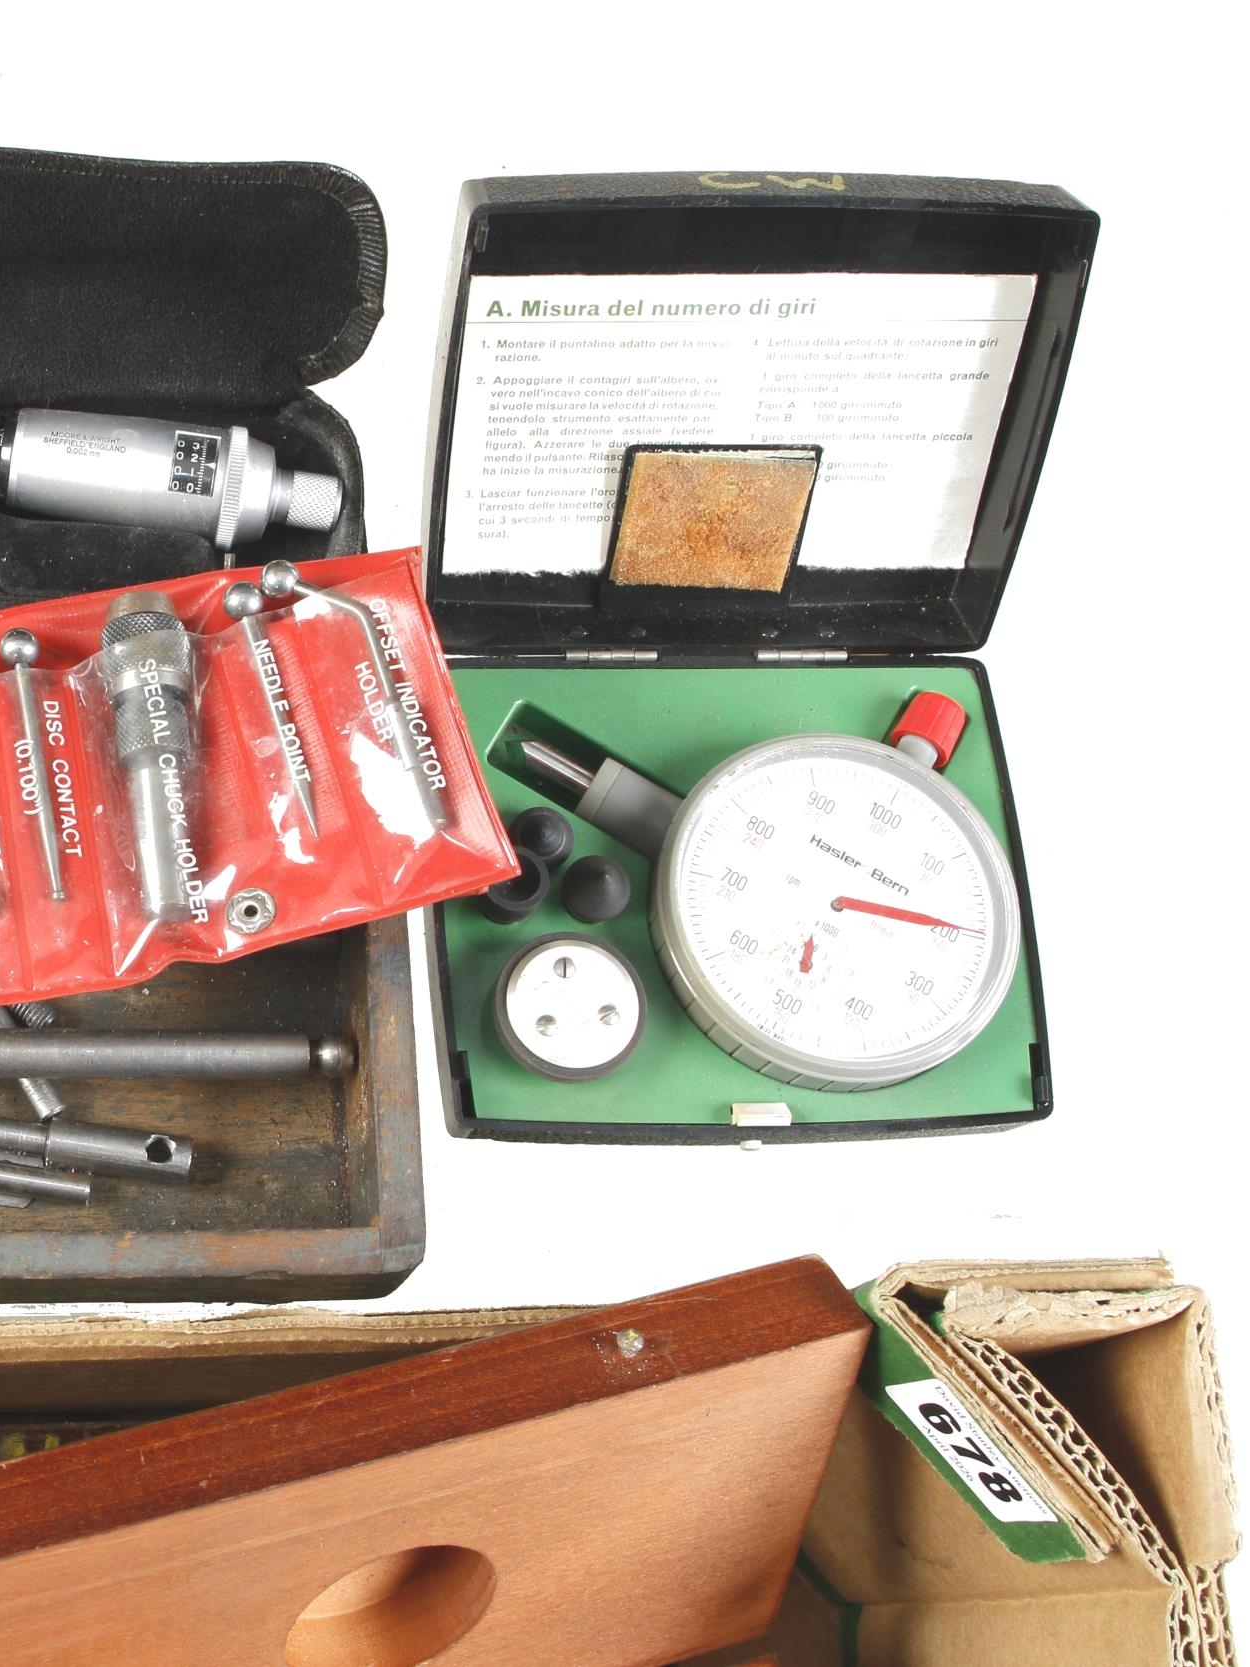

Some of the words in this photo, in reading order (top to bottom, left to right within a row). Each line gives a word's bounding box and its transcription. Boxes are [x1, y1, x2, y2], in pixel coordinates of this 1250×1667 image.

[486, 300, 512, 317] A.
[521, 300, 600, 317] Misura
[608, 300, 644, 317] del
[652, 303, 741, 317] numero
[750, 299, 771, 316] di
[778, 299, 816, 318] giri
[481, 340, 490, 350] 1.
[496, 340, 545, 350] Montare
[549, 340, 557, 350] il
[560, 340, 615, 353] puntalino
[619, 340, 656, 350] adatto
[660, 342, 679, 353] per
[813, 338, 840, 347] della
[893, 338, 904, 347] di
[909, 338, 963, 347] rotazione
[965, 338, 976, 347] in
[979, 338, 999, 350] giri
[495, 353, 541, 363] razione.
[476, 376, 486, 386] 2.
[493, 376, 562, 388] Appoggiare
[568, 376, 575, 386] il
[579, 376, 631, 388] contagiri
[636, 376, 700, 387] sull'albero,
[864, 372, 891, 381] della
[897, 371, 943, 381] lancetta
[949, 371, 990, 383] grande
[491, 390, 516, 399] vero
[519, 389, 581, 399] nell'incavo
[584, 389, 623, 399] conico
[626, 389, 686, 399] dell'albero
[690, 389, 700, 398] di
[489, 402, 500, 412] si
[502, 402, 533, 411] vuole
[535, 402, 587, 411] misurare
[589, 402, 599, 411] la
[602, 401, 646, 411] velocità
[648, 402, 659, 411] di
[661, 402, 719, 412] rotazione,
[488, 414, 546, 424] tenendolo
[552, 414, 611, 424] strumento
[618, 414, 688, 423] esattamente
[486, 427, 517, 437] allelo
[529, 427, 549, 437] alla
[560, 426, 613, 436] direzione
[622, 426, 662, 435] assiale
[671, 426, 714, 436] (vedere
[849, 433, 876, 441] della
[882, 433, 926, 441] lancetta
[933, 432, 973, 443] piccola
[485, 440, 526, 450] figura).
[534, 440, 585, 449] Azzerare
[591, 440, 602, 449] le
[608, 440, 630, 449] due
[484, 453, 523, 463] mendo
[526, 453, 531, 462] il
[534, 453, 585, 465] pulsante.
[483, 466, 496, 475] ha
[500, 466, 530, 475] inizio
[534, 466, 544, 475] la
[548, 466, 621, 475] misurazione.
[464, 490, 474, 499] 3.
[480, 489, 522, 498] Lasciar
[526, 489, 586, 498] funzionare
[479, 501, 524, 511] l'arresto
[528, 501, 555, 511] delle
[559, 501, 603, 510] lancette
[478, 515, 495, 525] cui
[500, 515, 507, 524] 3
[511, 515, 556, 524] secondi
[560, 515, 570, 524] di
[576, 514, 611, 526] tempo
[477, 529, 510, 539] sura).
[354, 661, 395, 743] HOLDER
[368, 598, 407, 672] OFFSET
[395, 681, 447, 790] INDICATOR
[253, 639, 289, 713] NEEDLE
[280, 723, 311, 783] POINT
[43, 700, 65, 747] DISC
[138, 658, 171, 745] SPECIAL
[158, 753, 188, 828] CHUCK
[176, 838, 209, 924] HOLDER
[52, 759, 83, 858] CONTACT
[807, 790, 836, 815] 900
[869, 802, 902, 830] 1000
[746, 815, 775, 840] 800
[810, 834, 862, 869] Hasler
[871, 868, 910, 897] Bern
[922, 852, 945, 876] 100
[721, 867, 748, 892] 700
[729, 930, 759, 955] 600
[905, 970, 934, 996] 300
[772, 988, 803, 1015] 500
[844, 996, 874, 1021] 400
[922, 1425, 950, 1452] April
[919, 1403, 1023, 1503] 678
